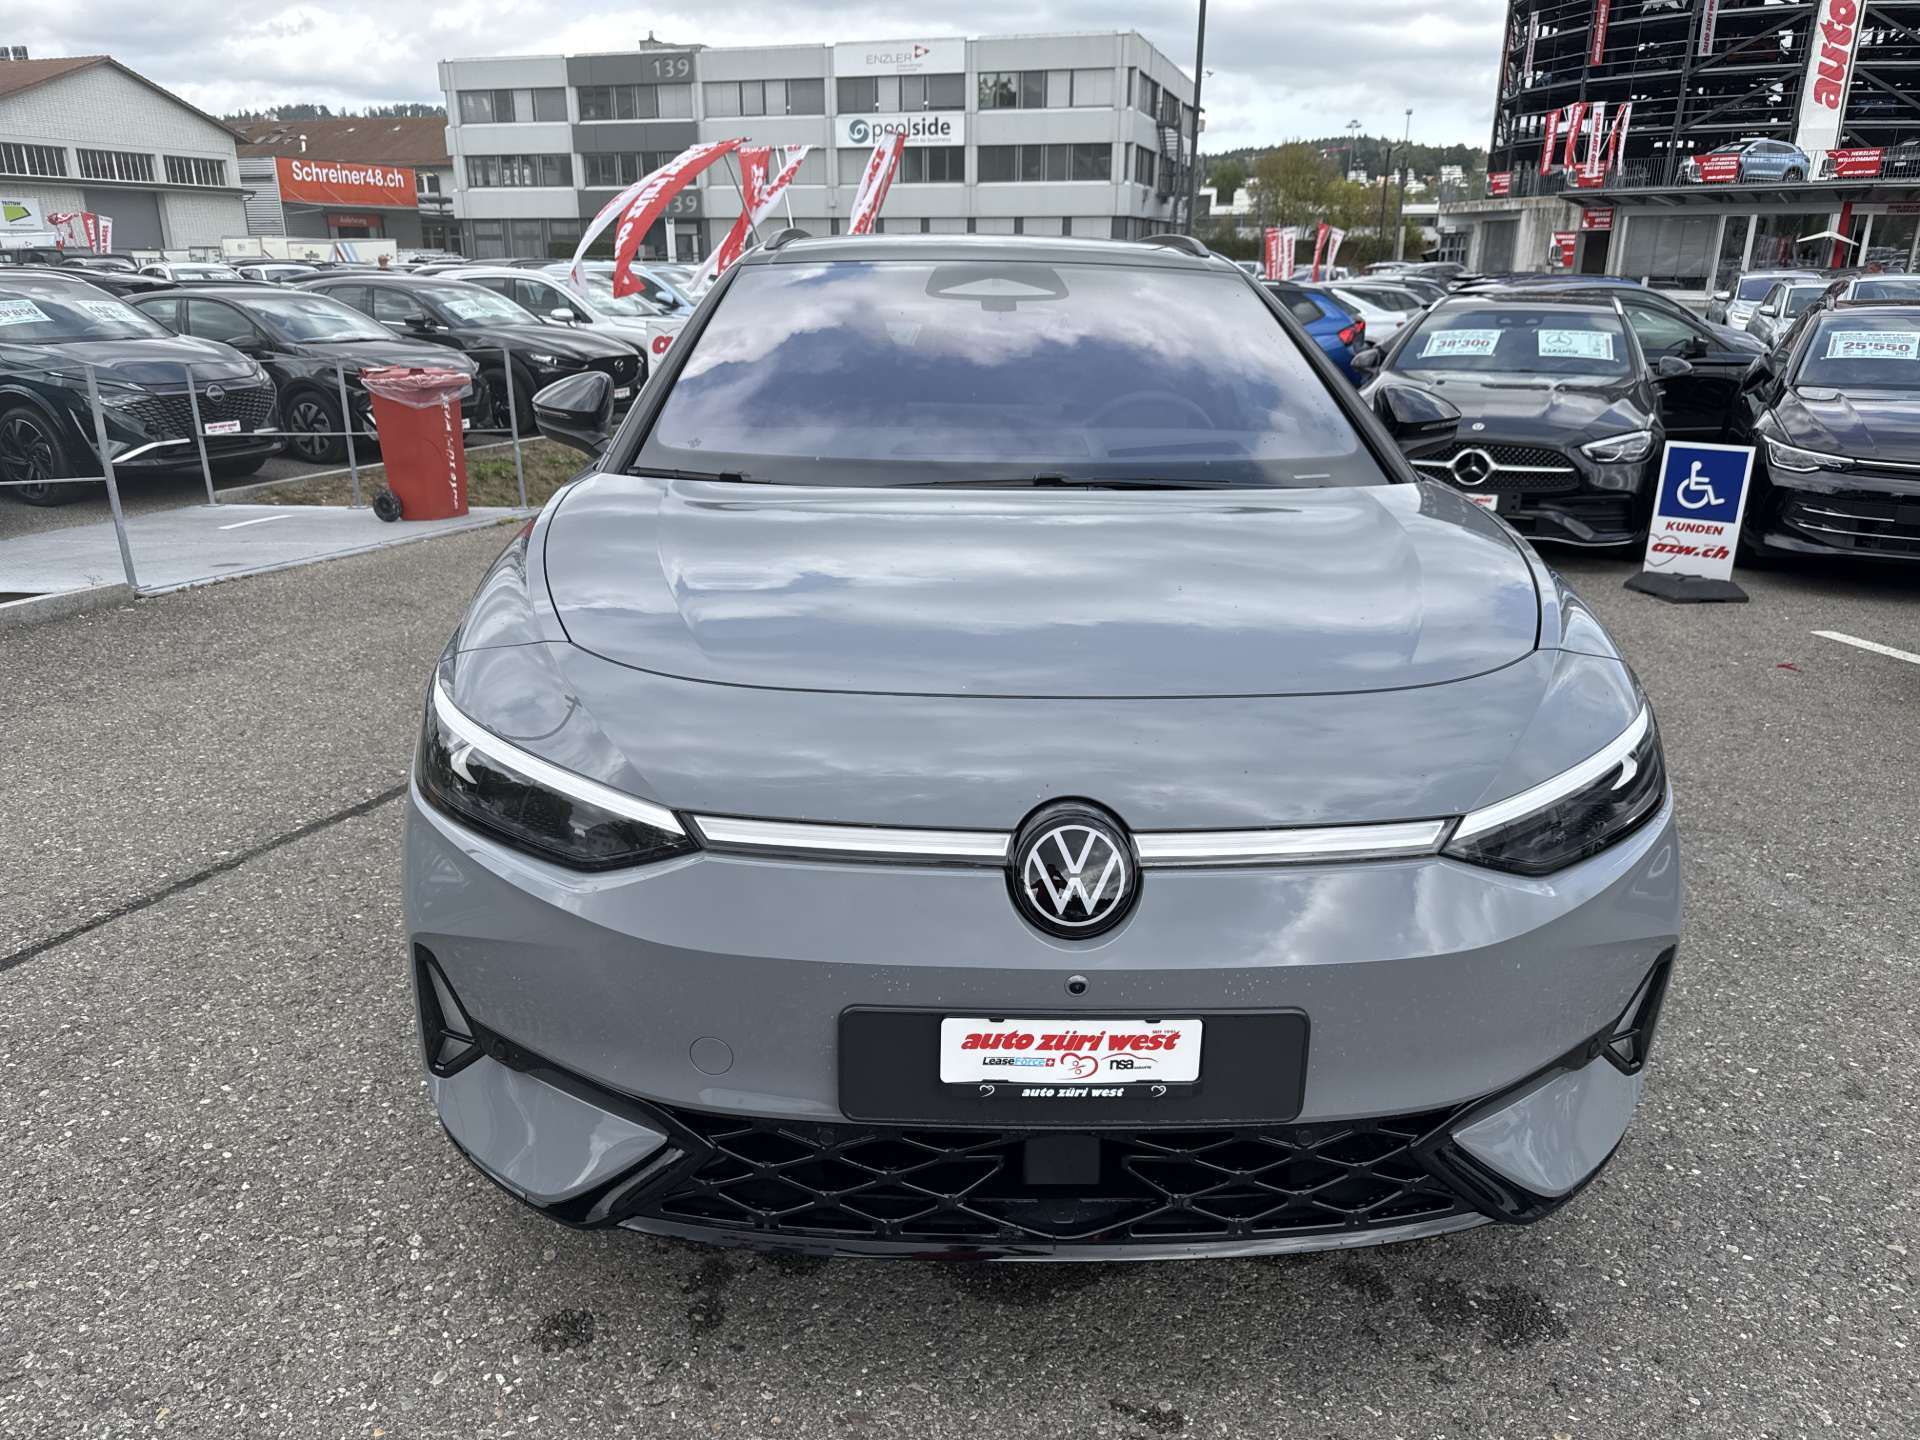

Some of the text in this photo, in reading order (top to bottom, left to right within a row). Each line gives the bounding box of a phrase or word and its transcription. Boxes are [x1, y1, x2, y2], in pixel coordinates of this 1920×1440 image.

[866, 53, 912, 65] ENZLER
[1814, 0, 1857, 109] auto
[653, 59, 689, 77] 139
[872, 117, 951, 144] poolside
[292, 161, 405, 188] Schreiner48.ch
[1843, 342, 1910, 351] 25'550
[1665, 521, 1724, 536] KUNDEN
[1651, 543, 1729, 560] azw.ch
[961, 1030, 1181, 1051] auto züri west
[1110, 1060, 1134, 1070] nsa
[1022, 1087, 1124, 1097] auto züri west
